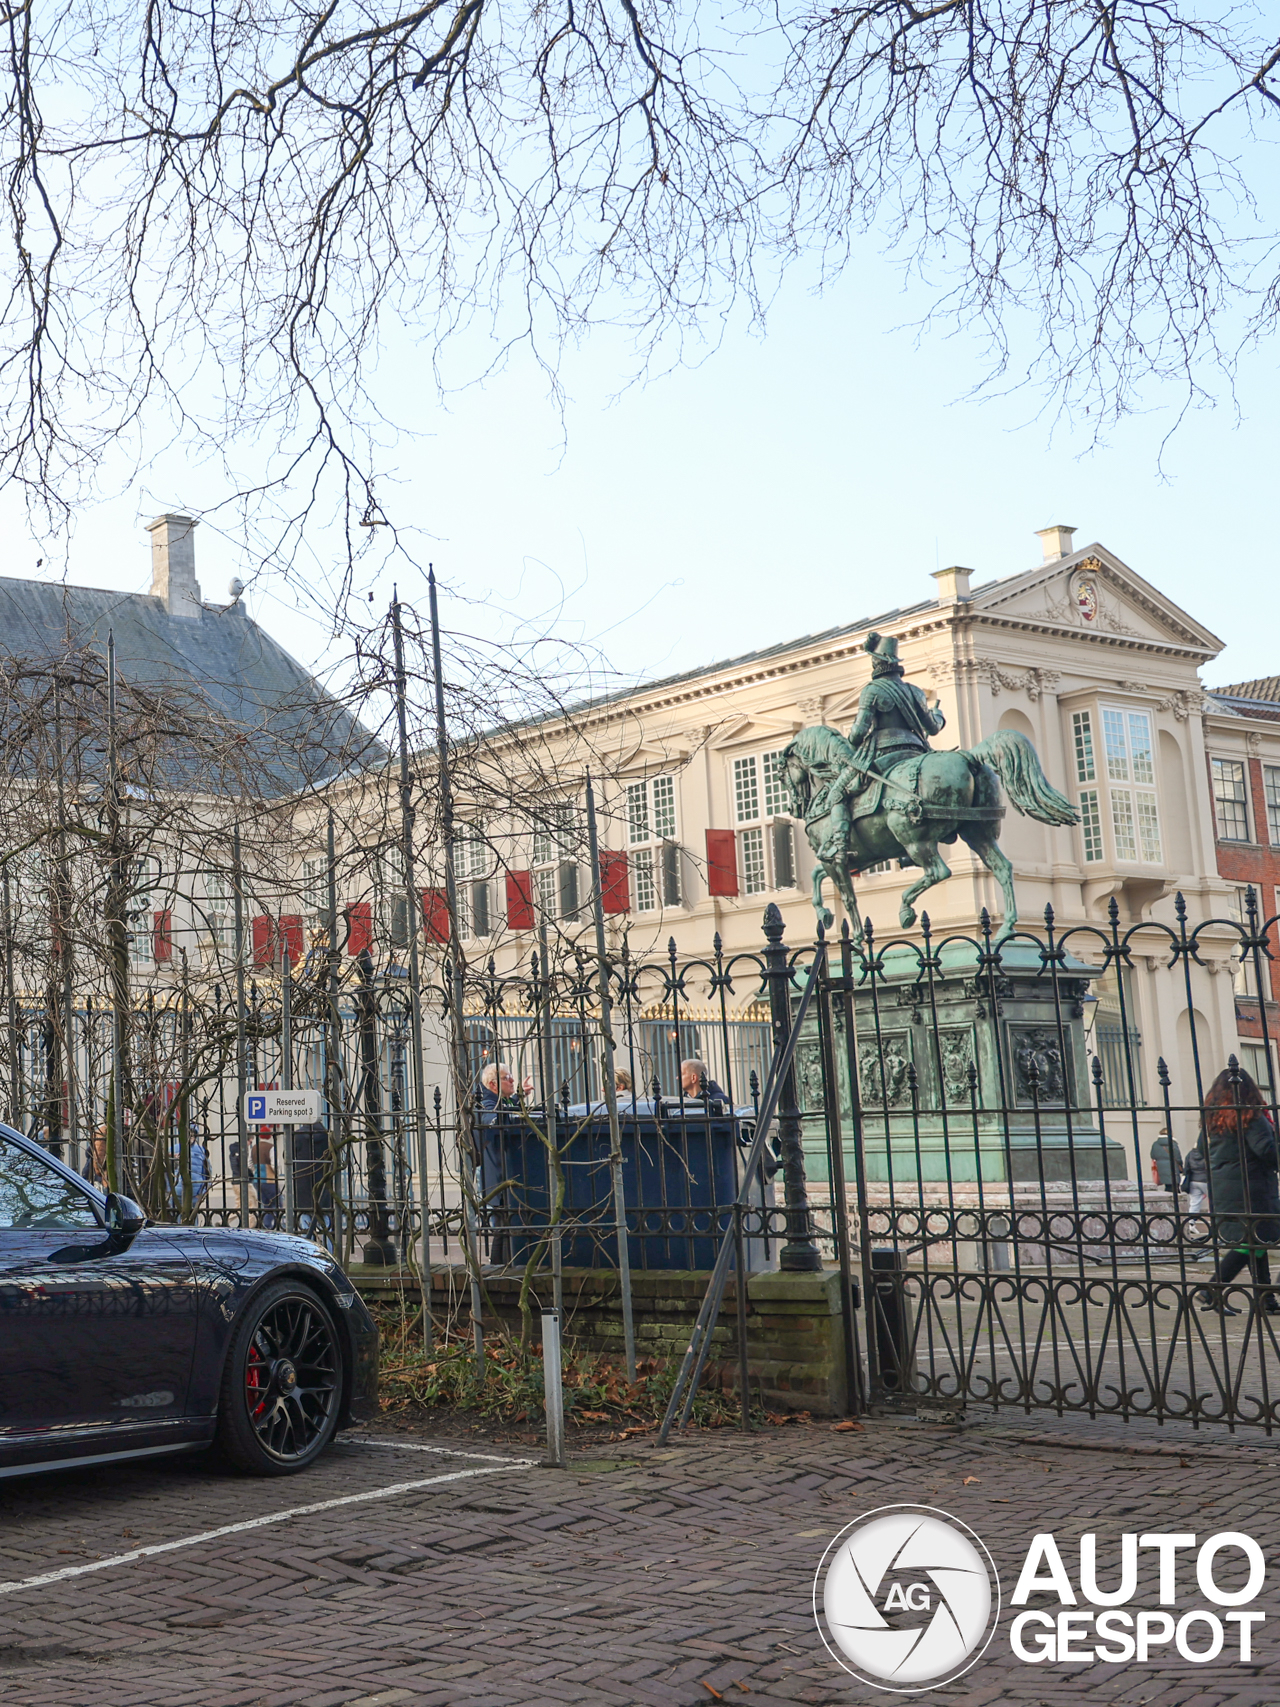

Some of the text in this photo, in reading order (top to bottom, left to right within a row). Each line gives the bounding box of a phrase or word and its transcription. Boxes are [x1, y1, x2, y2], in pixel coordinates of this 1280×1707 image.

[276, 1098, 306, 1106] Reserved
[252, 1100, 262, 1116] P
[269, 1107, 314, 1117] Parking spot 3
